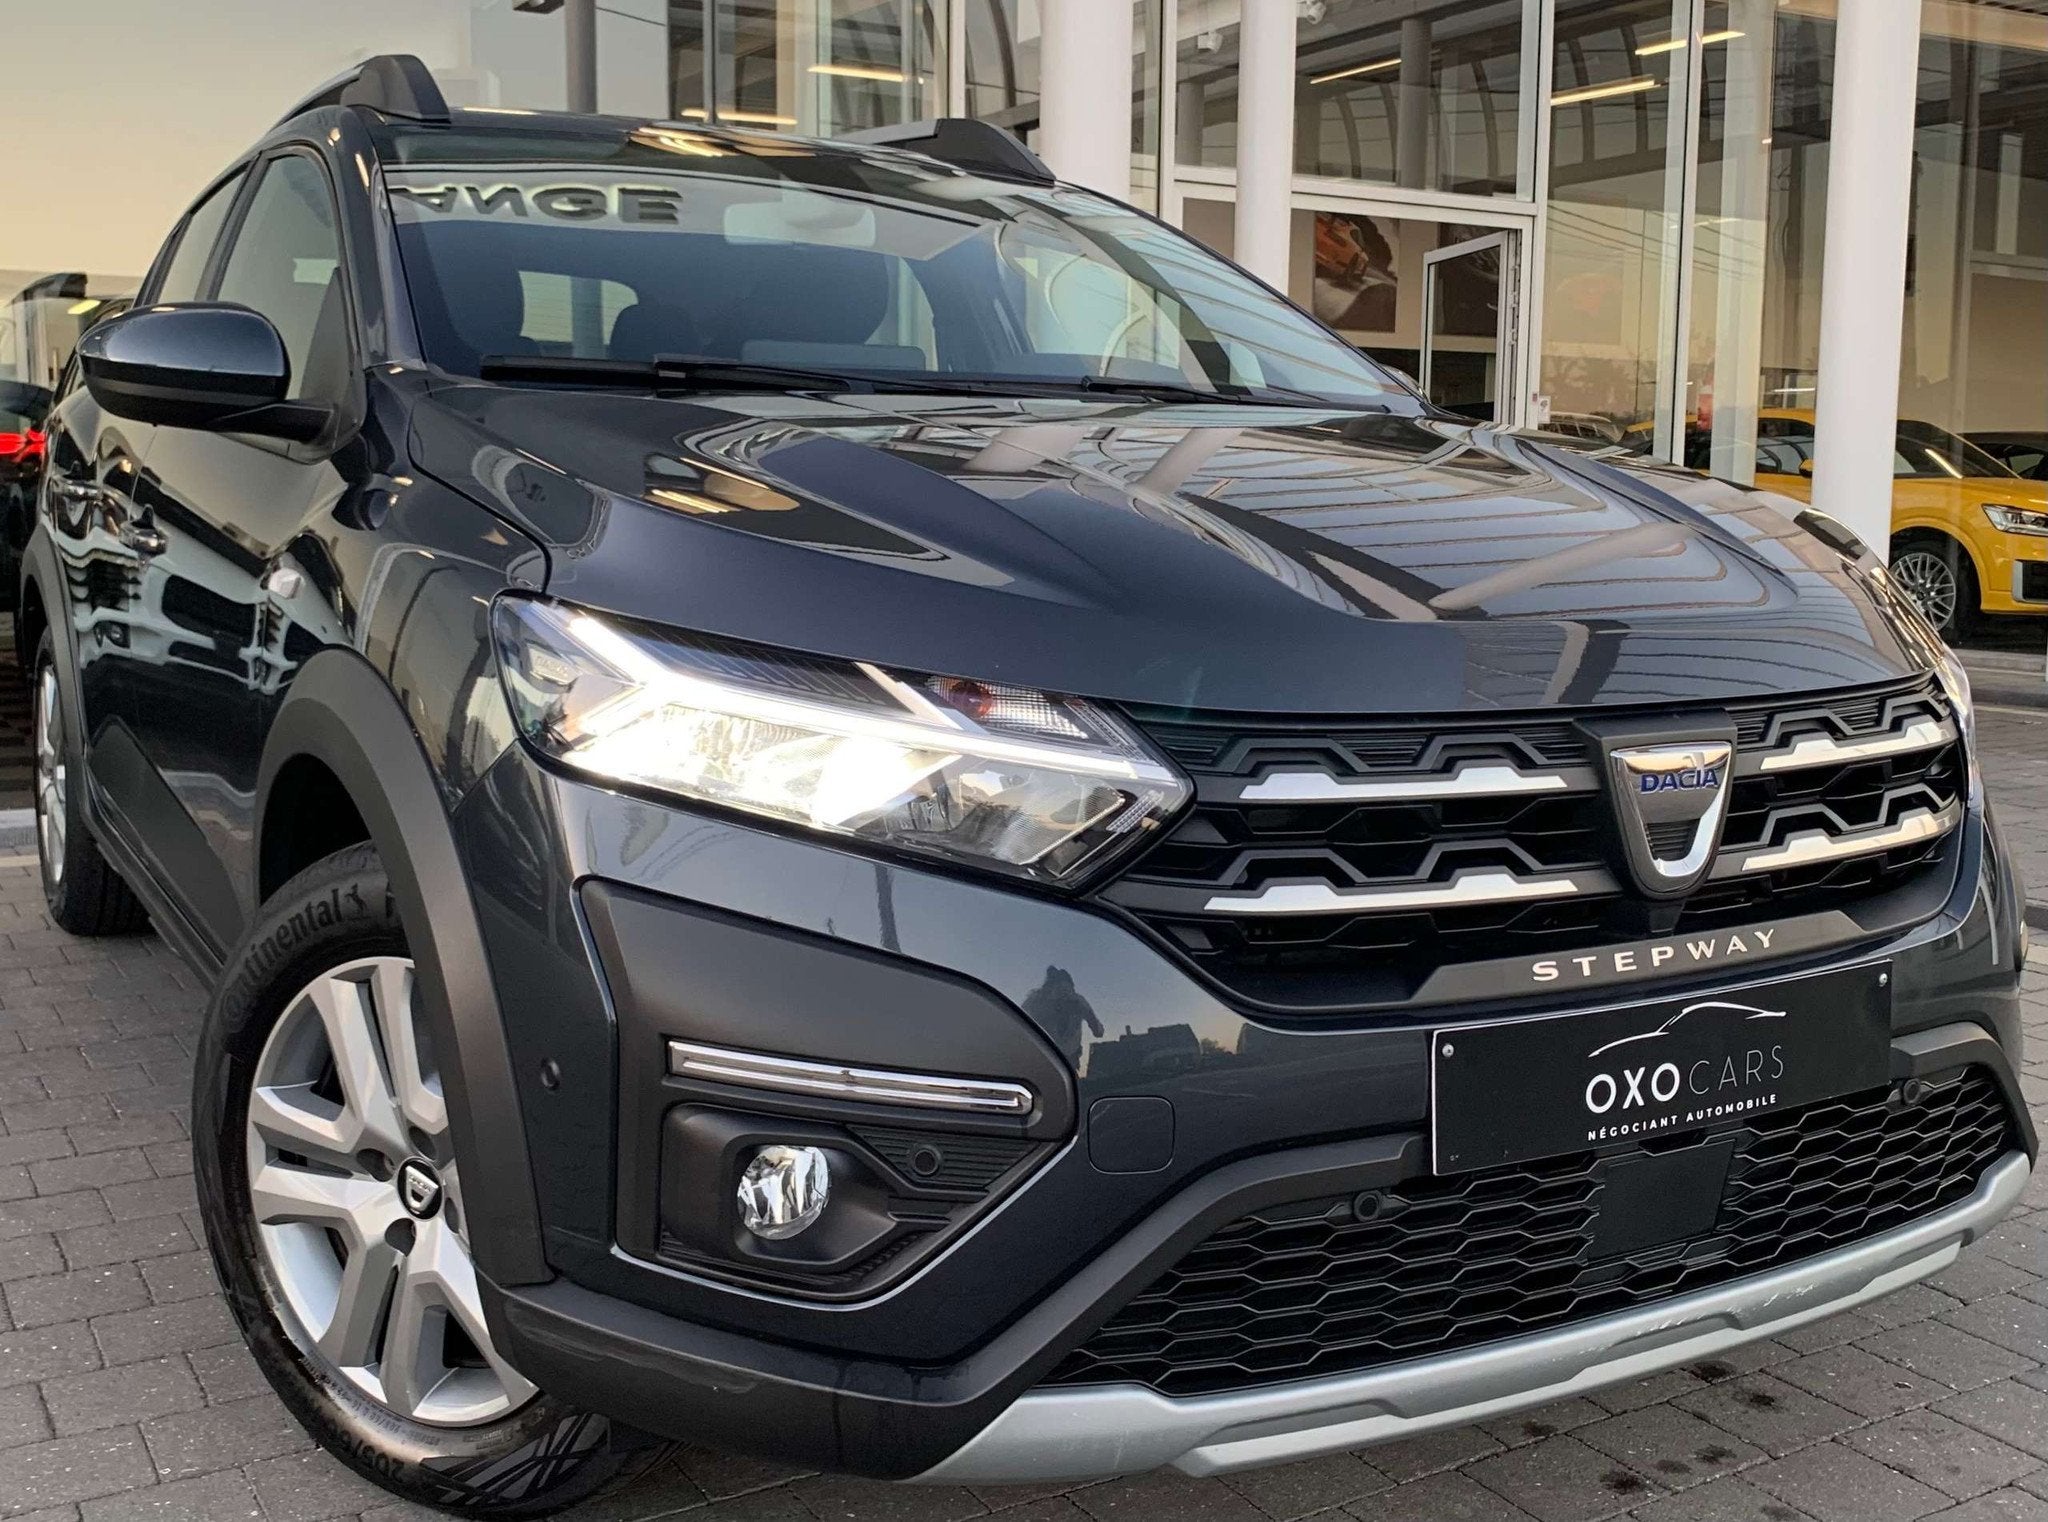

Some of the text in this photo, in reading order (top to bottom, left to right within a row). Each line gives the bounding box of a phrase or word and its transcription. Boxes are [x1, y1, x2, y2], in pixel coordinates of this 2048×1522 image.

[1640, 768, 1719, 793] DACIA
[1532, 928, 1775, 982] STEPWAY
[1588, 1093, 1777, 1141] NÉGOCIANT AUTOMOBILE
